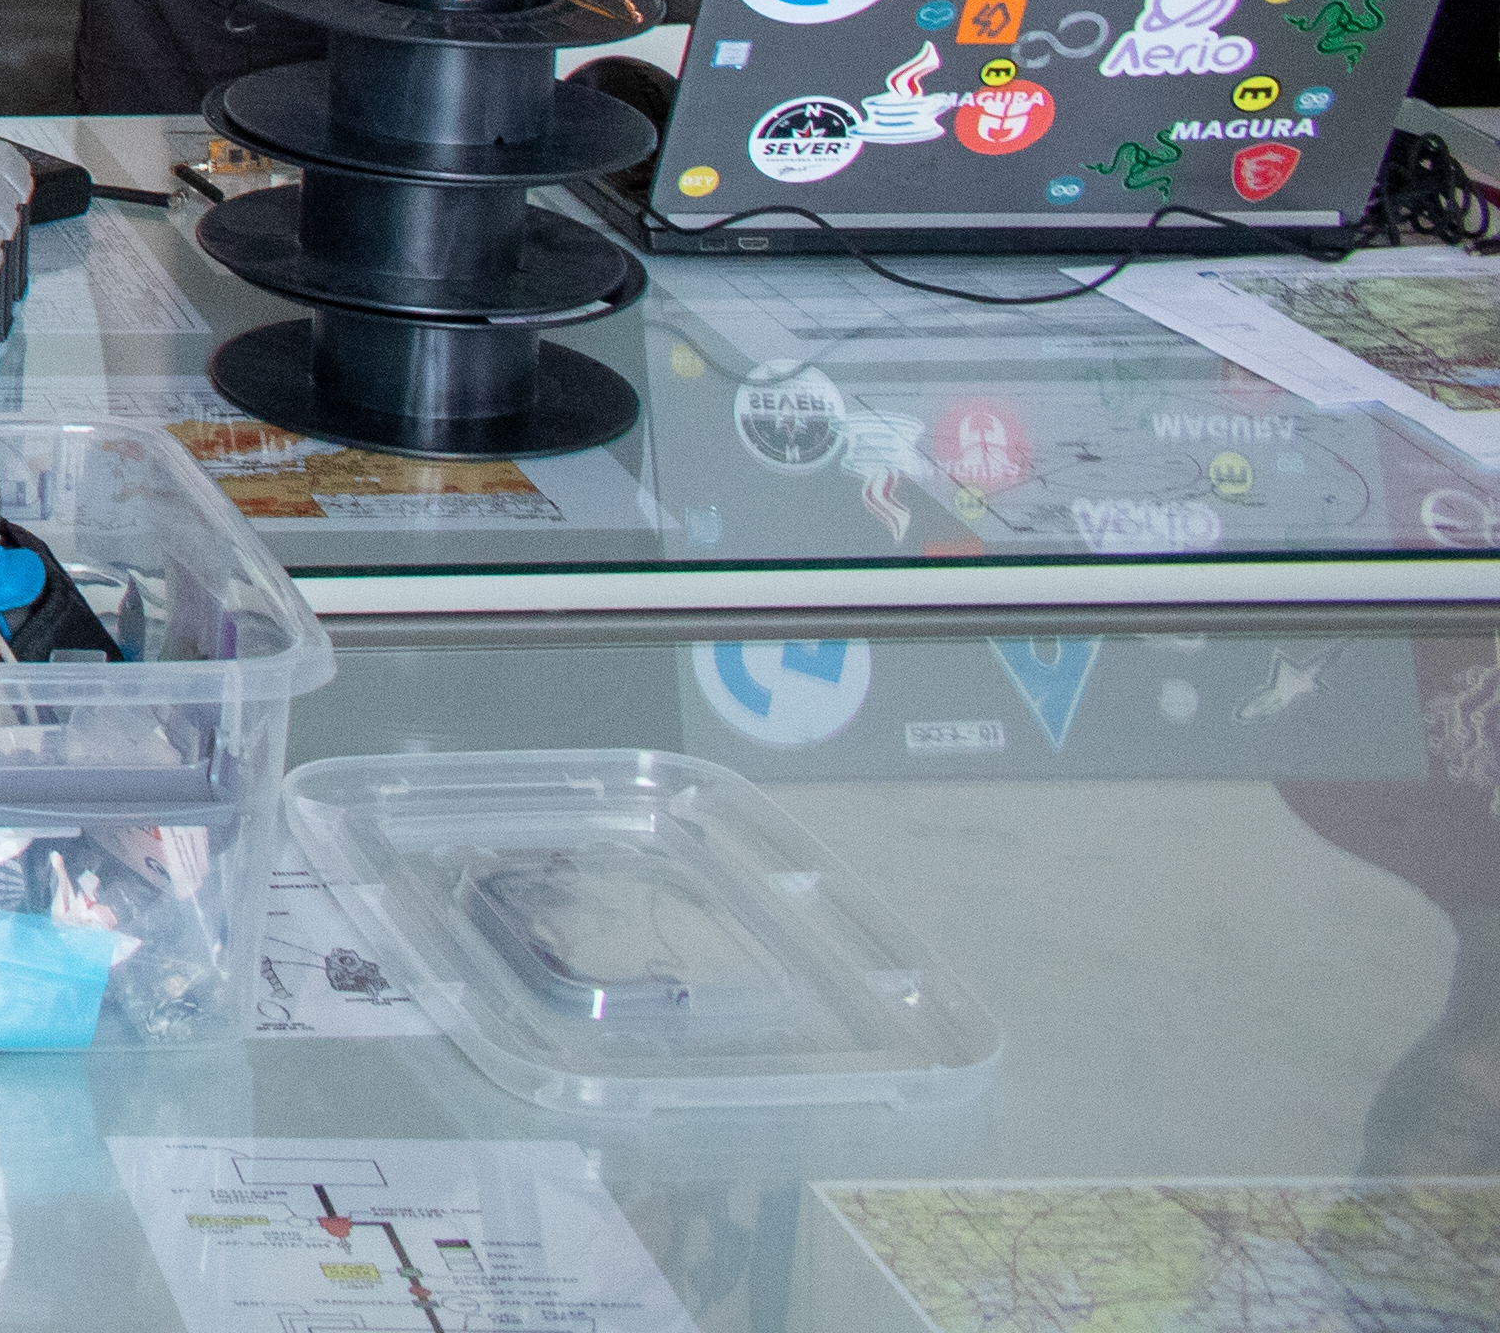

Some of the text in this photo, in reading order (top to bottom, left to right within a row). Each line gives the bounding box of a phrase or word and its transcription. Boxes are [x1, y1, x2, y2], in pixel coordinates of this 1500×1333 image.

[1108, 35, 1246, 74] Aerio
[804, 103, 822, 118] N
[1169, 117, 1318, 142] MAGURA
